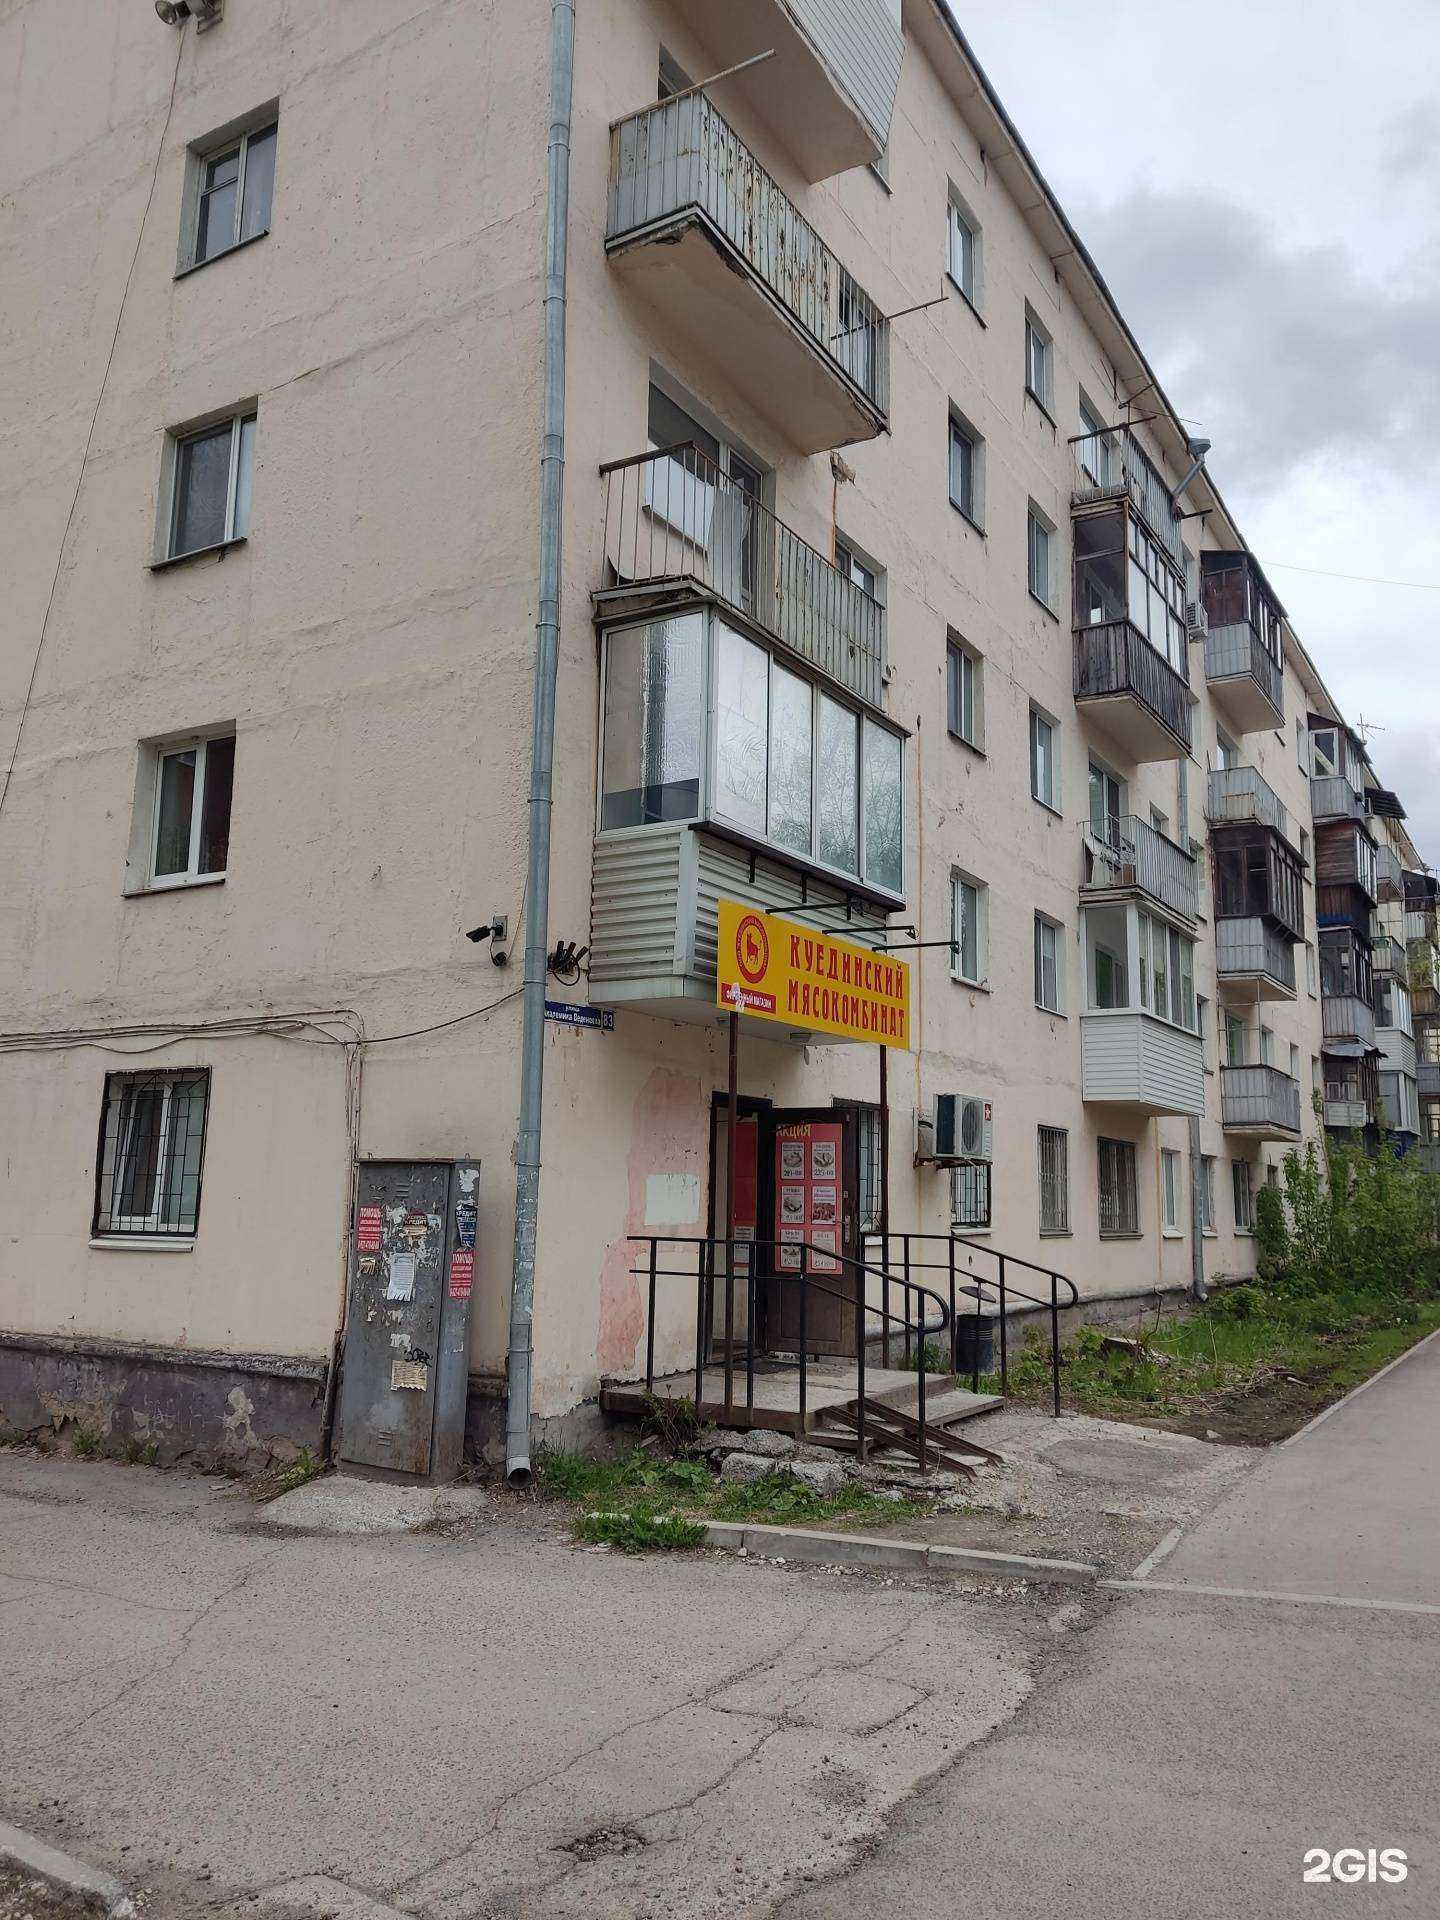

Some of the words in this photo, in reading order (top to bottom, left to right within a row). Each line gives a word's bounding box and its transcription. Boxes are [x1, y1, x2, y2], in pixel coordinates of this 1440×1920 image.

[789, 934, 904, 1000] КУЕДИНСКИЙ
[603, 1014, 613, 1027] 83
[787, 978, 905, 1038] МЯСОКОМБИНАТ
[776, 1124, 811, 1139] АКЦИЯ
